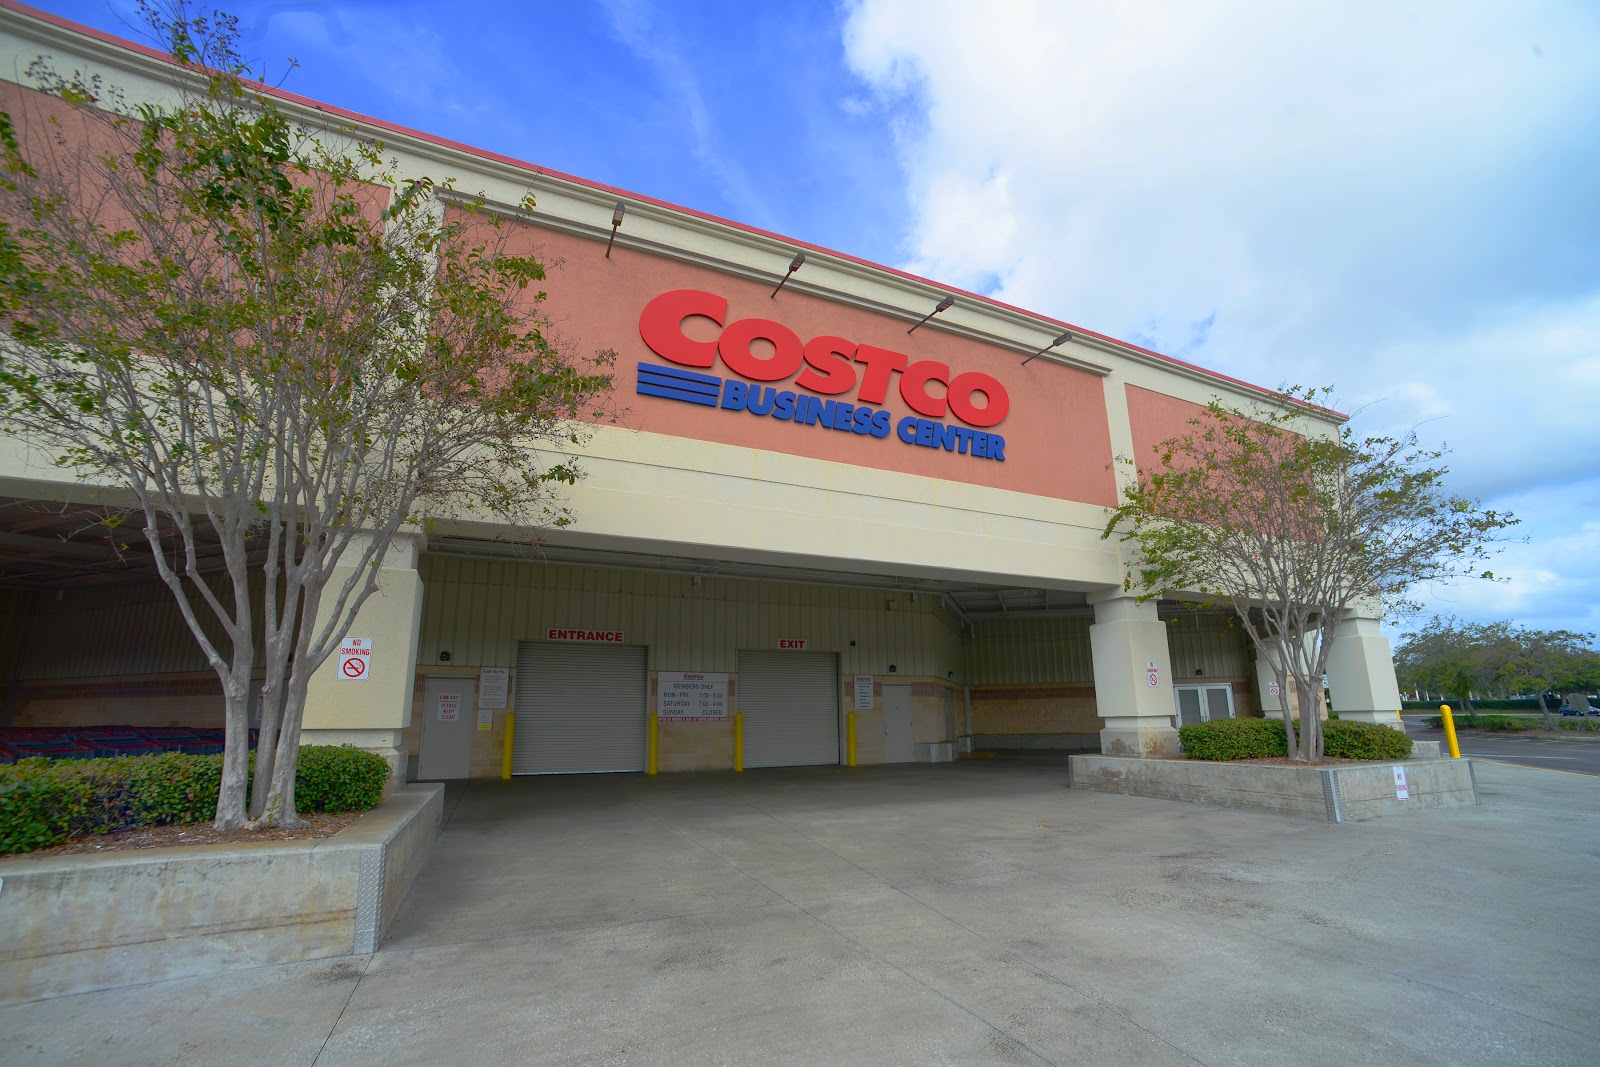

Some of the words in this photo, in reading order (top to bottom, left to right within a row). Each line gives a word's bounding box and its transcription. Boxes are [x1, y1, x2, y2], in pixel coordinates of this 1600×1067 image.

[639, 289, 1010, 427] COSTCO
[721, 379, 891, 438] BUSINESS
[896, 415, 1006, 462] CENTER
[548, 630, 623, 642] ENTRANCE
[780, 640, 804, 648] EXIT
[341, 648, 370, 656] SMOKING
